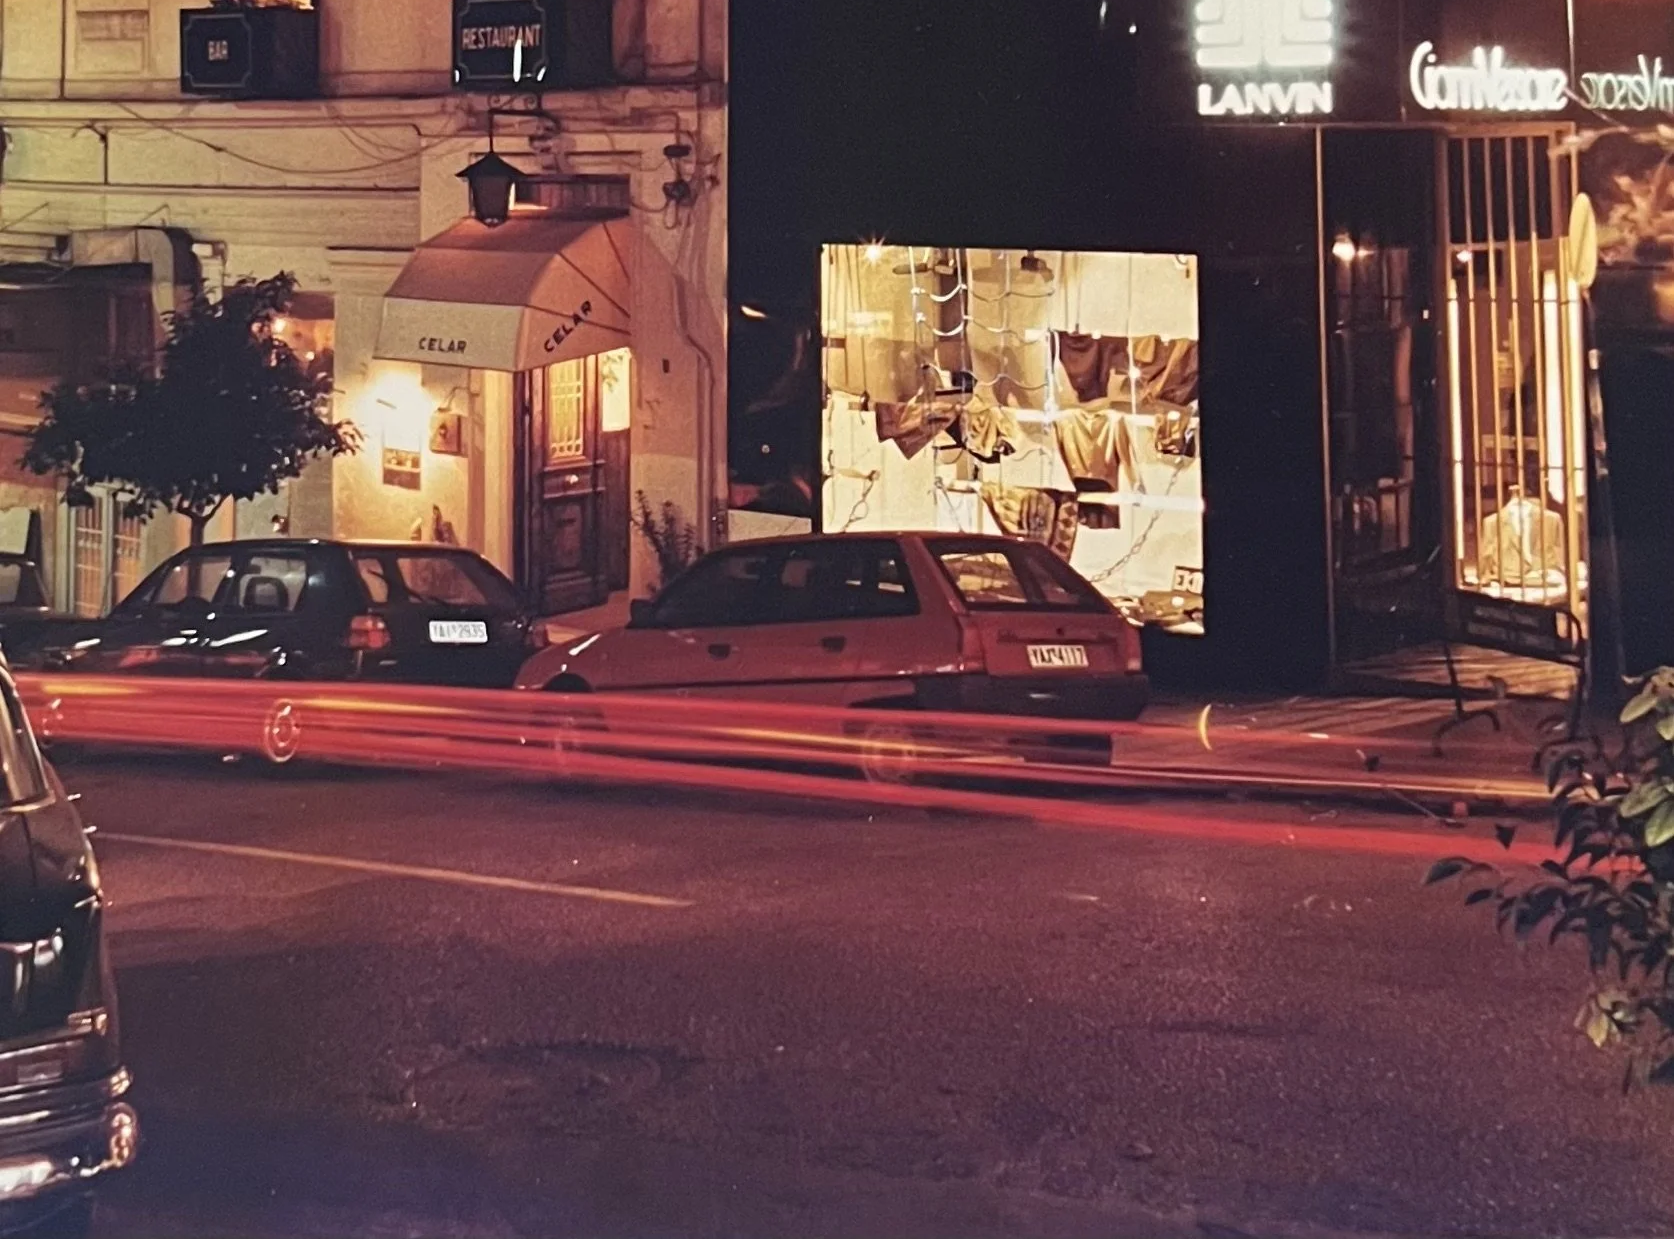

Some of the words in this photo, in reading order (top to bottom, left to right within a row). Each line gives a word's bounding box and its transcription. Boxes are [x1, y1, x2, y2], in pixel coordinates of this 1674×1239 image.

[462, 23, 540, 49] RESTAURANT
[207, 40, 229, 60] BAR
[1198, 82, 1333, 115] LANVIN
[544, 300, 593, 353] CELAR
[418, 336, 466, 354] CELAR
